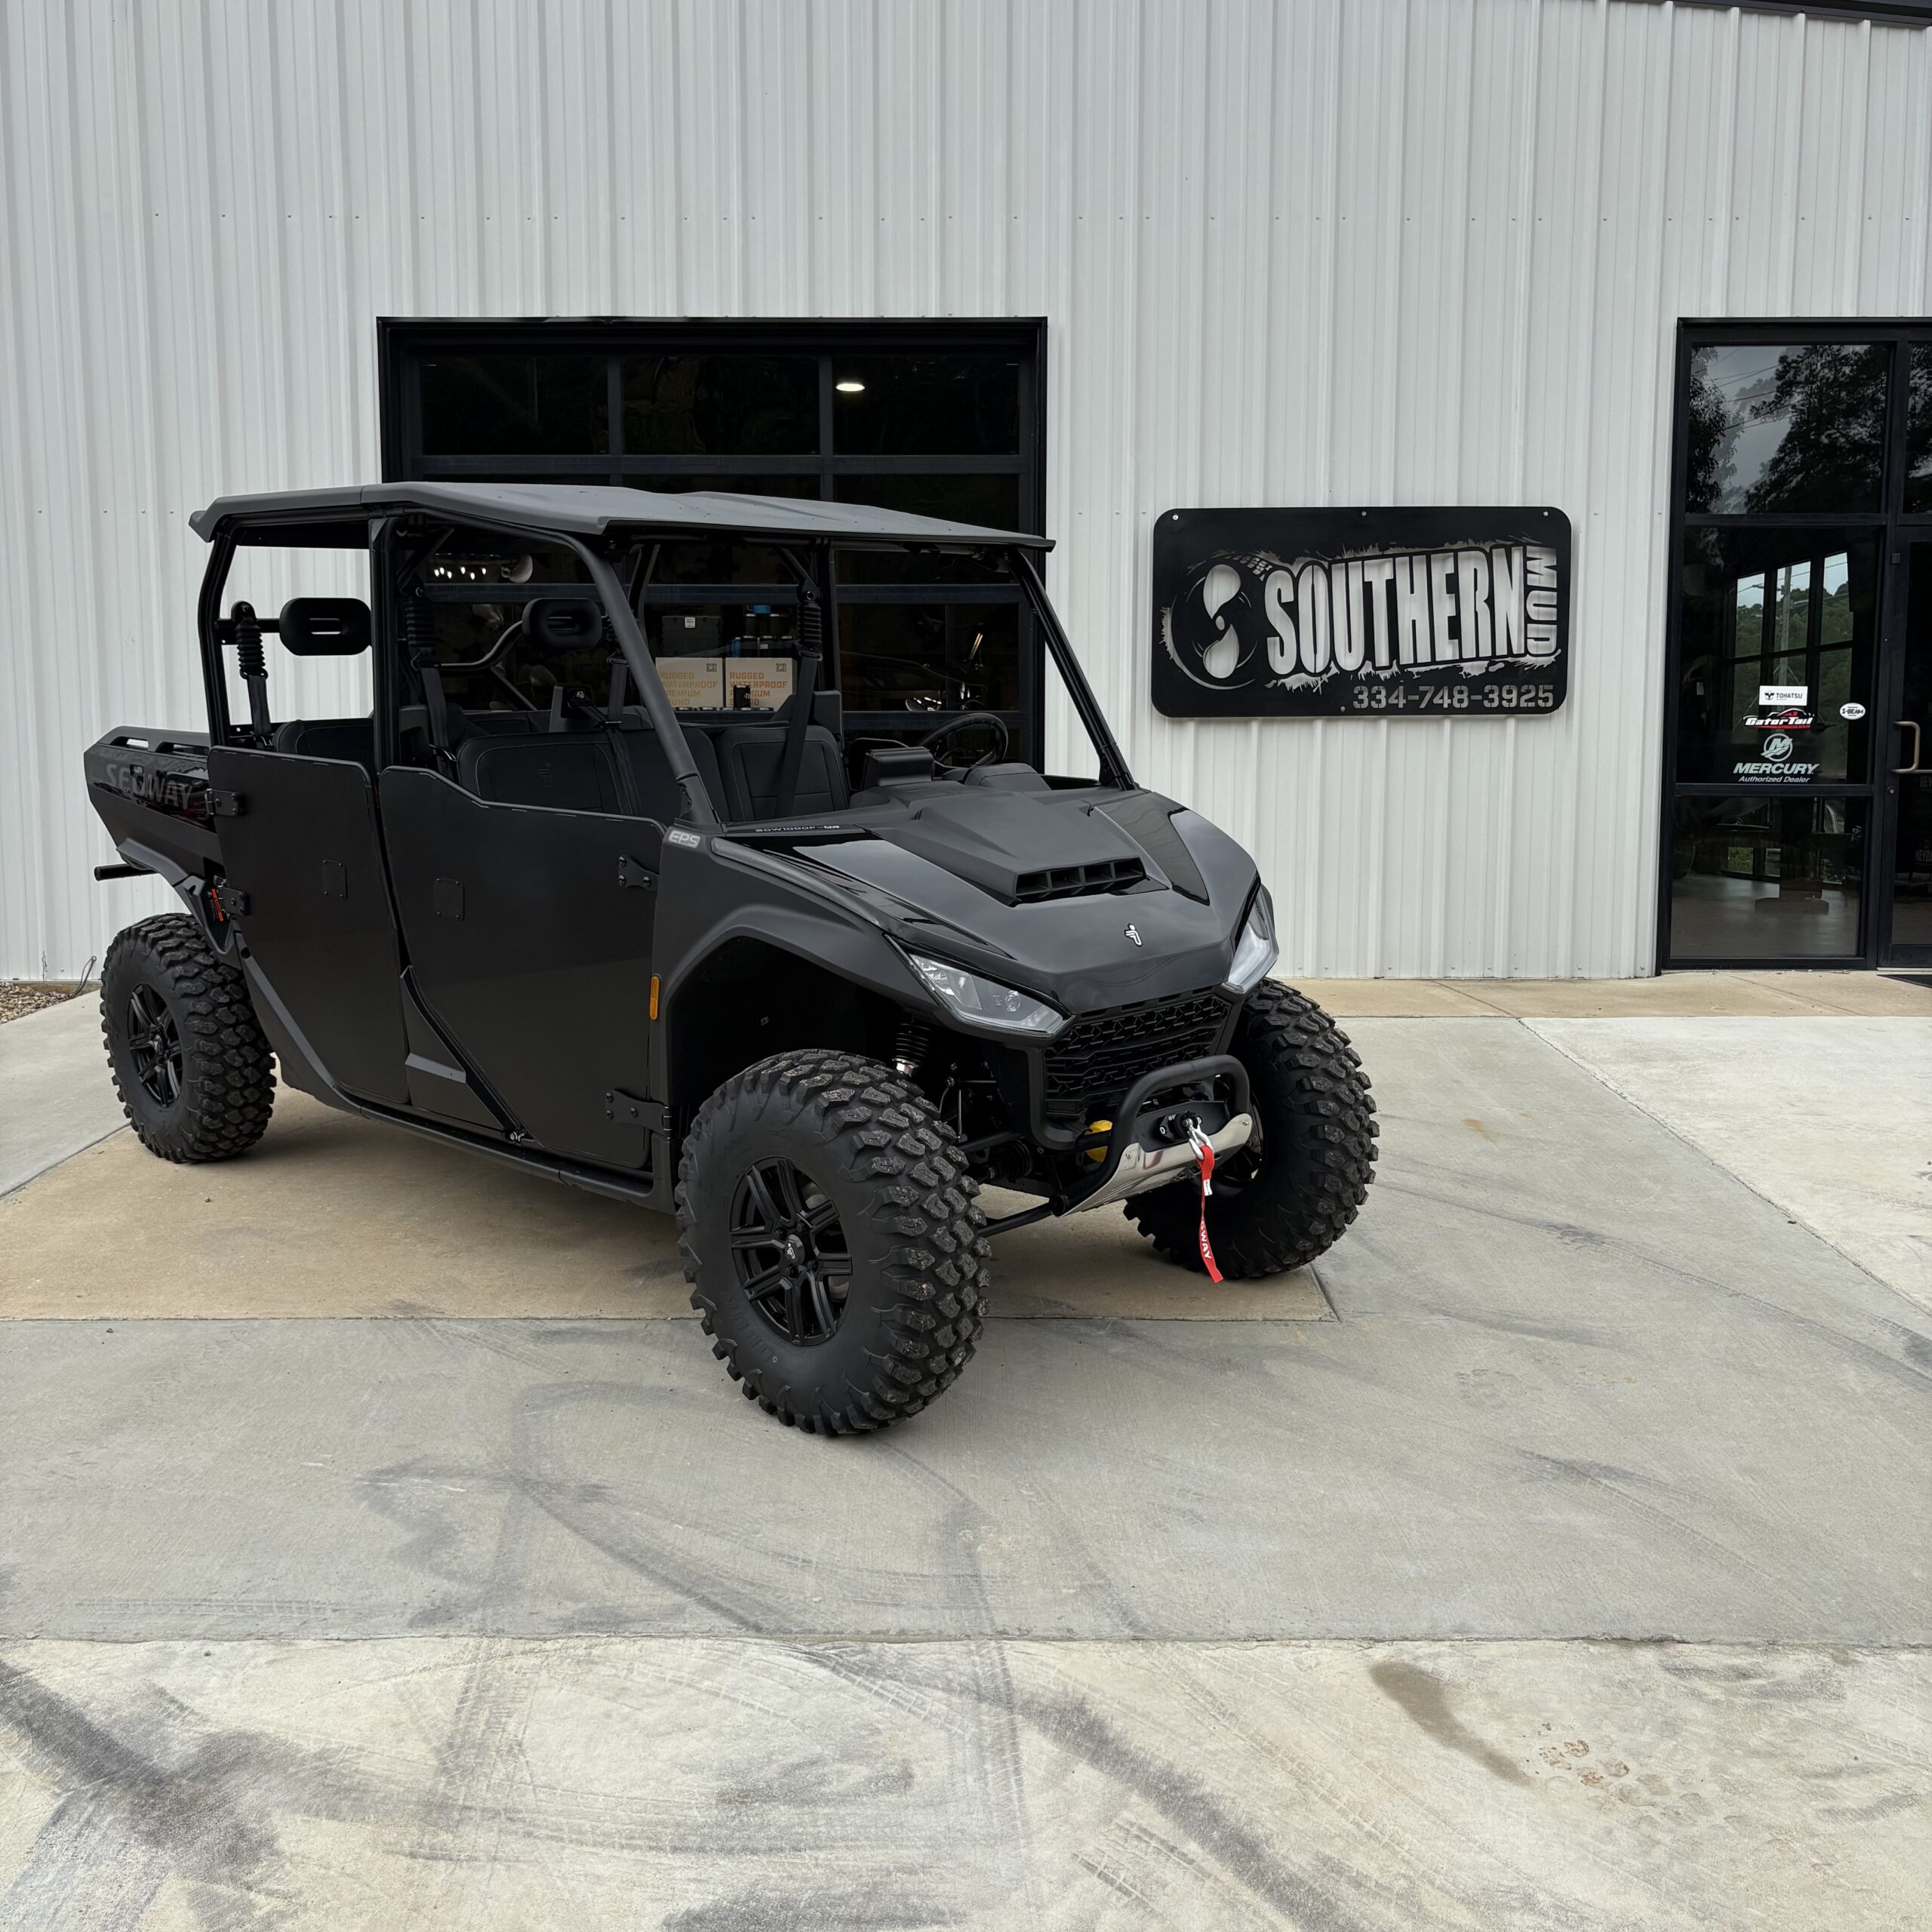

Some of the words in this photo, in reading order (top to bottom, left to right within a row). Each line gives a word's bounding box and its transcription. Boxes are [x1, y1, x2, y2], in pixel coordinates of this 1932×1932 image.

[1264, 546, 1523, 675] SOUTHERN
[1525, 546, 1557, 656] MUD
[1352, 685, 1554, 708] 334-748-3925
[1745, 716, 1814, 726] GatorTail
[1733, 762, 1820, 774] MERCURY
[668, 830, 700, 849] EPS
